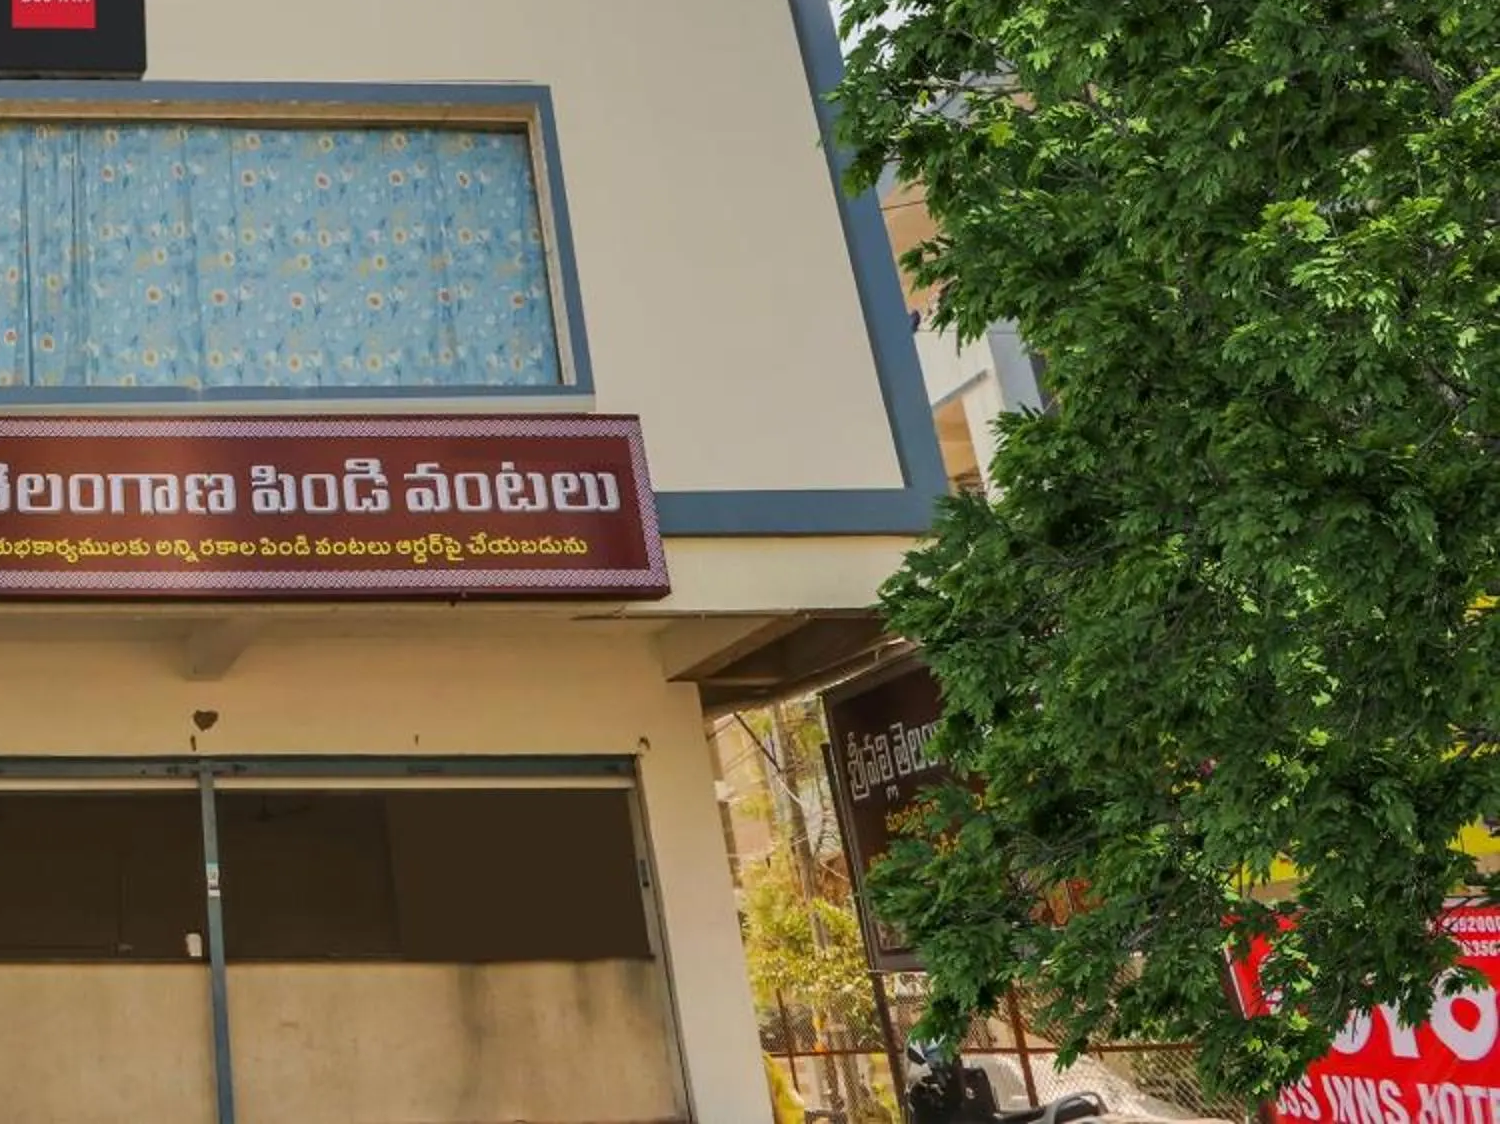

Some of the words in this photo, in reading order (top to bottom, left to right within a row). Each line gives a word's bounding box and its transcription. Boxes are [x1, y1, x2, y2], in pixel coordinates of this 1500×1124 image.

[251, 457, 391, 514] పిండి
[403, 461, 621, 513] వంటలు
[1320, 1074, 1411, 1124] INNS
